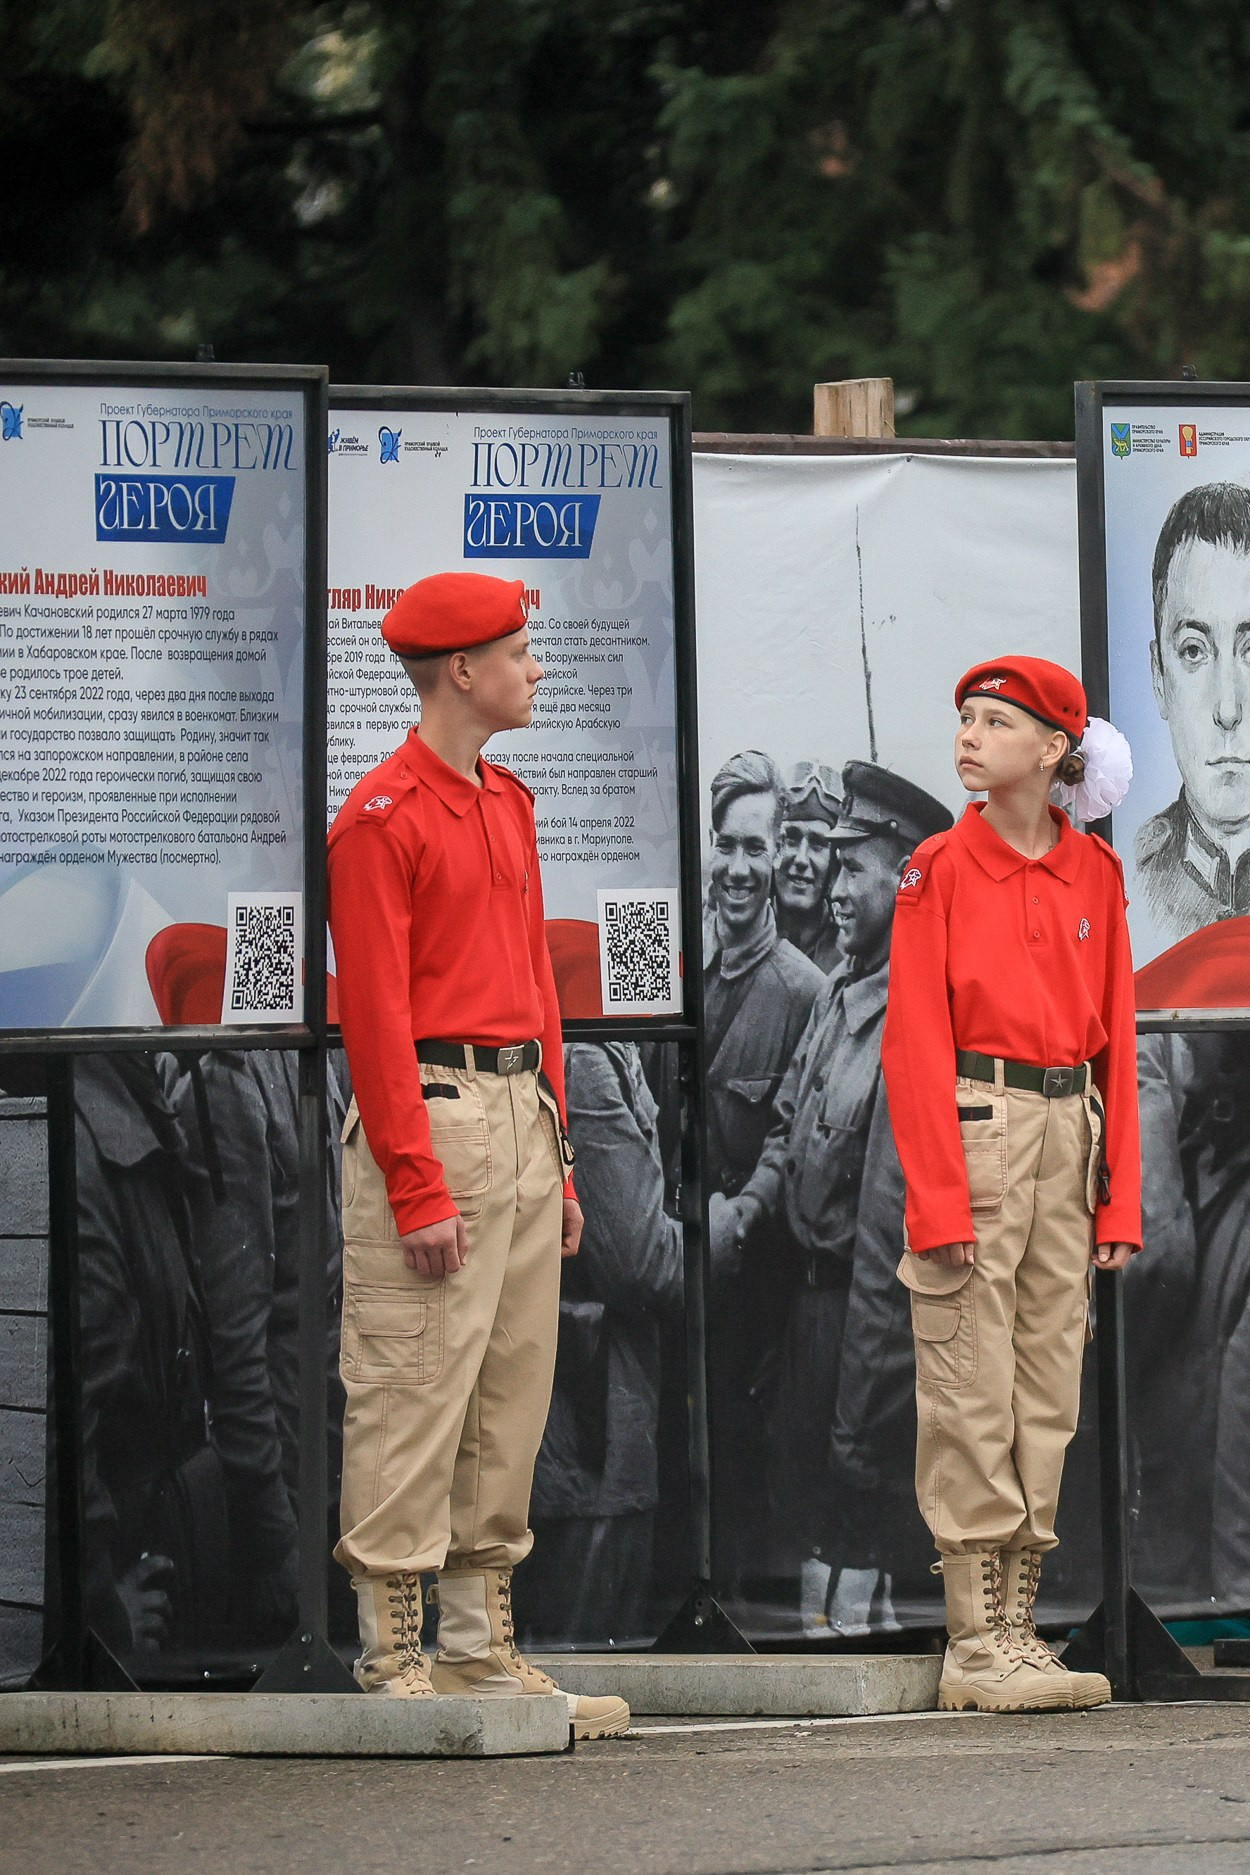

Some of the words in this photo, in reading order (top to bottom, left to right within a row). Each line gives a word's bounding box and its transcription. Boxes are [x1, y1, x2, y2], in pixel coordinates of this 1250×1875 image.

[100, 403, 134, 415] Проект
[136, 404, 200, 418] Губернатора
[202, 406, 268, 420] Приморского
[270, 410, 292, 420] края
[474, 426, 506, 439] Проект
[508, 427, 568, 440] Губернатора
[571, 428, 634, 441] Приморского
[636, 431, 657, 441] края
[34, 568, 99, 599] Андрей
[104, 569, 206, 598] Николаевич
[24, 604, 93, 618] Качановский
[96, 608, 139, 622] родился
[142, 605, 152, 619] 27
[156, 609, 187, 622] марта
[190, 606, 210, 619] 1979
[212, 610, 234, 622] года
[548, 618, 561, 629] Со
[563, 618, 589, 629] своей
[591, 618, 629, 632] будущей
[0, 624, 13, 637] По
[16, 627, 79, 640] достижении
[83, 625, 92, 638] 18
[94, 628, 112, 639] лет
[115, 629, 155, 642] прошёл
[158, 629, 202, 643] срочную
[205, 627, 239, 644] службу
[241, 631, 246, 640] в
[249, 630, 278, 644] рядах
[531, 637, 562, 646] мечтал
[564, 637, 587, 646] стать
[589, 637, 649, 647] десантником.
[545, 651, 605, 665] Вооруженных
[607, 654, 623, 662] сил
[34, 706, 105, 722] мобилизации,
[108, 710, 138, 724] сразу
[140, 710, 174, 721] явился
[177, 711, 182, 721] в
[185, 711, 237, 721] военкомат.
[240, 708, 278, 722] Близким
[485, 753, 510, 765] сразу
[512, 753, 538, 762] после
[541, 753, 573, 762] начала
[575, 751, 634, 763] специальной
[548, 767, 565, 778] был
[568, 769, 616, 780] направлен
[618, 769, 657, 780] старший
[18, 808, 54, 822] Указом
[58, 808, 118, 825] Президента
[122, 809, 180, 822] Российской
[182, 810, 238, 826] Федерации
[240, 810, 280, 825] рядовой
[550, 817, 566, 828] бой
[569, 816, 577, 827] 14
[580, 819, 611, 830] апреля
[614, 816, 634, 827] 2022
[568, 836, 572, 844] в
[574, 836, 579, 844] г.
[582, 832, 634, 847] Мариуполе.
[59, 853, 104, 866] орденом
[108, 849, 157, 866] Мужества
[160, 849, 220, 866] (посмертно).
[550, 850, 599, 864] награждён
[601, 852, 639, 863] орденом
